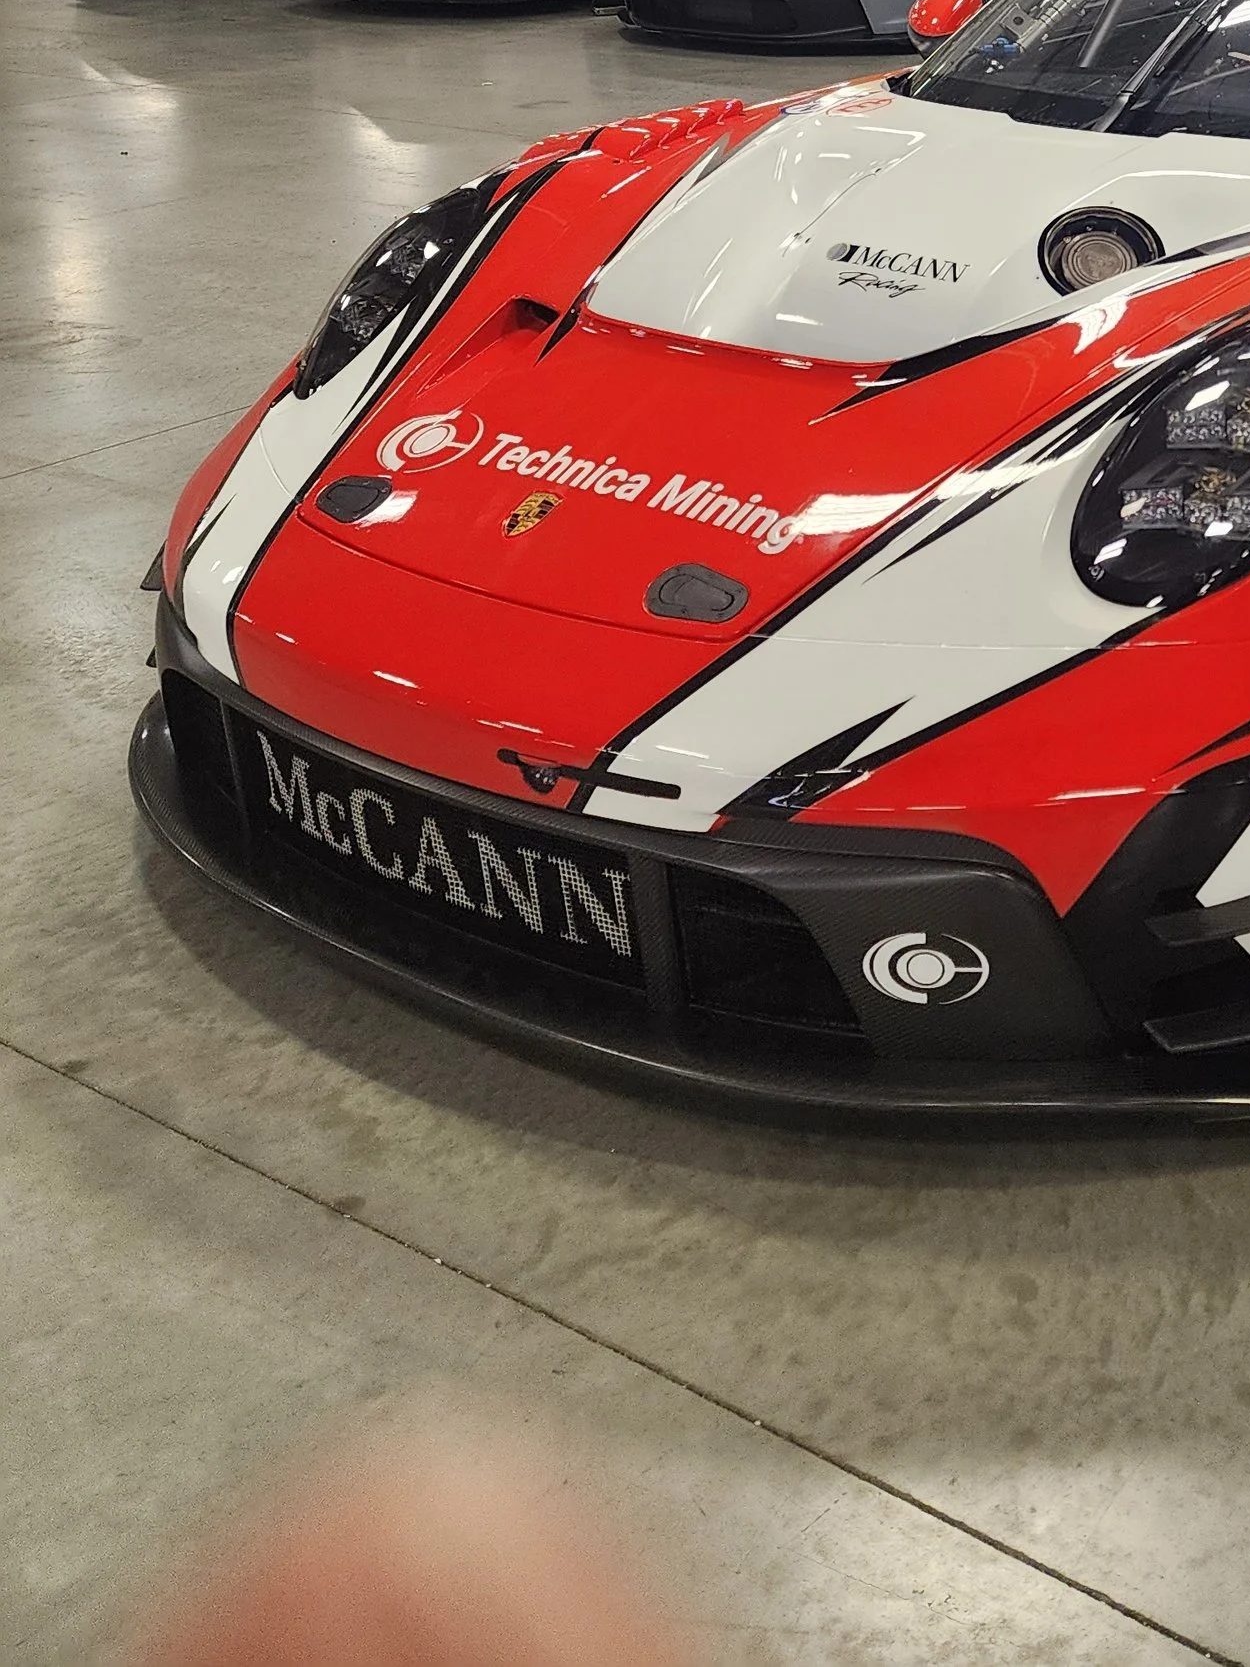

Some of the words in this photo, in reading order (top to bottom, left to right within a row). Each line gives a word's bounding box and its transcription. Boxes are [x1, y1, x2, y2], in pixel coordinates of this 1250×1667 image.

[838, 271, 926, 298] Racing
[853, 246, 971, 283] McCANN
[478, 433, 649, 502] Technica
[646, 474, 803, 556] Mining
[255, 729, 632, 957] McCANN
